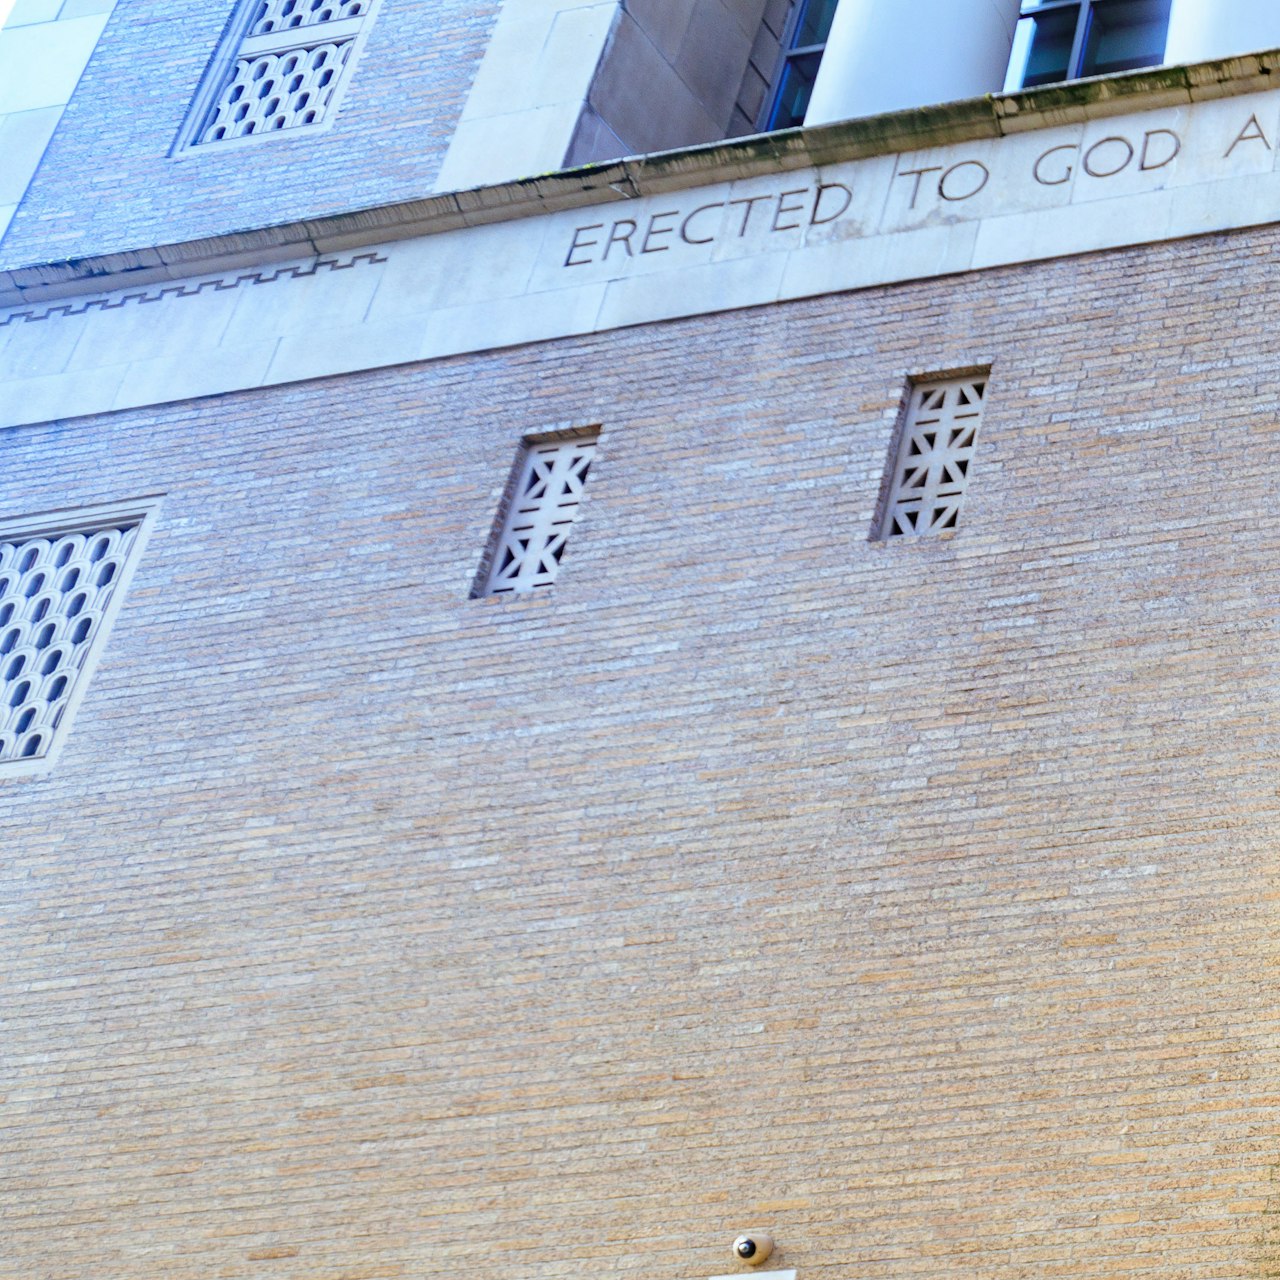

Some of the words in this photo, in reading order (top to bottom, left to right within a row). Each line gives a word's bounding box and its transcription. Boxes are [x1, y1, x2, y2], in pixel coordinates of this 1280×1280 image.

[565, 183, 852, 267] ERECTED
[899, 160, 988, 208] TO
[1033, 129, 1181, 186] GOD
